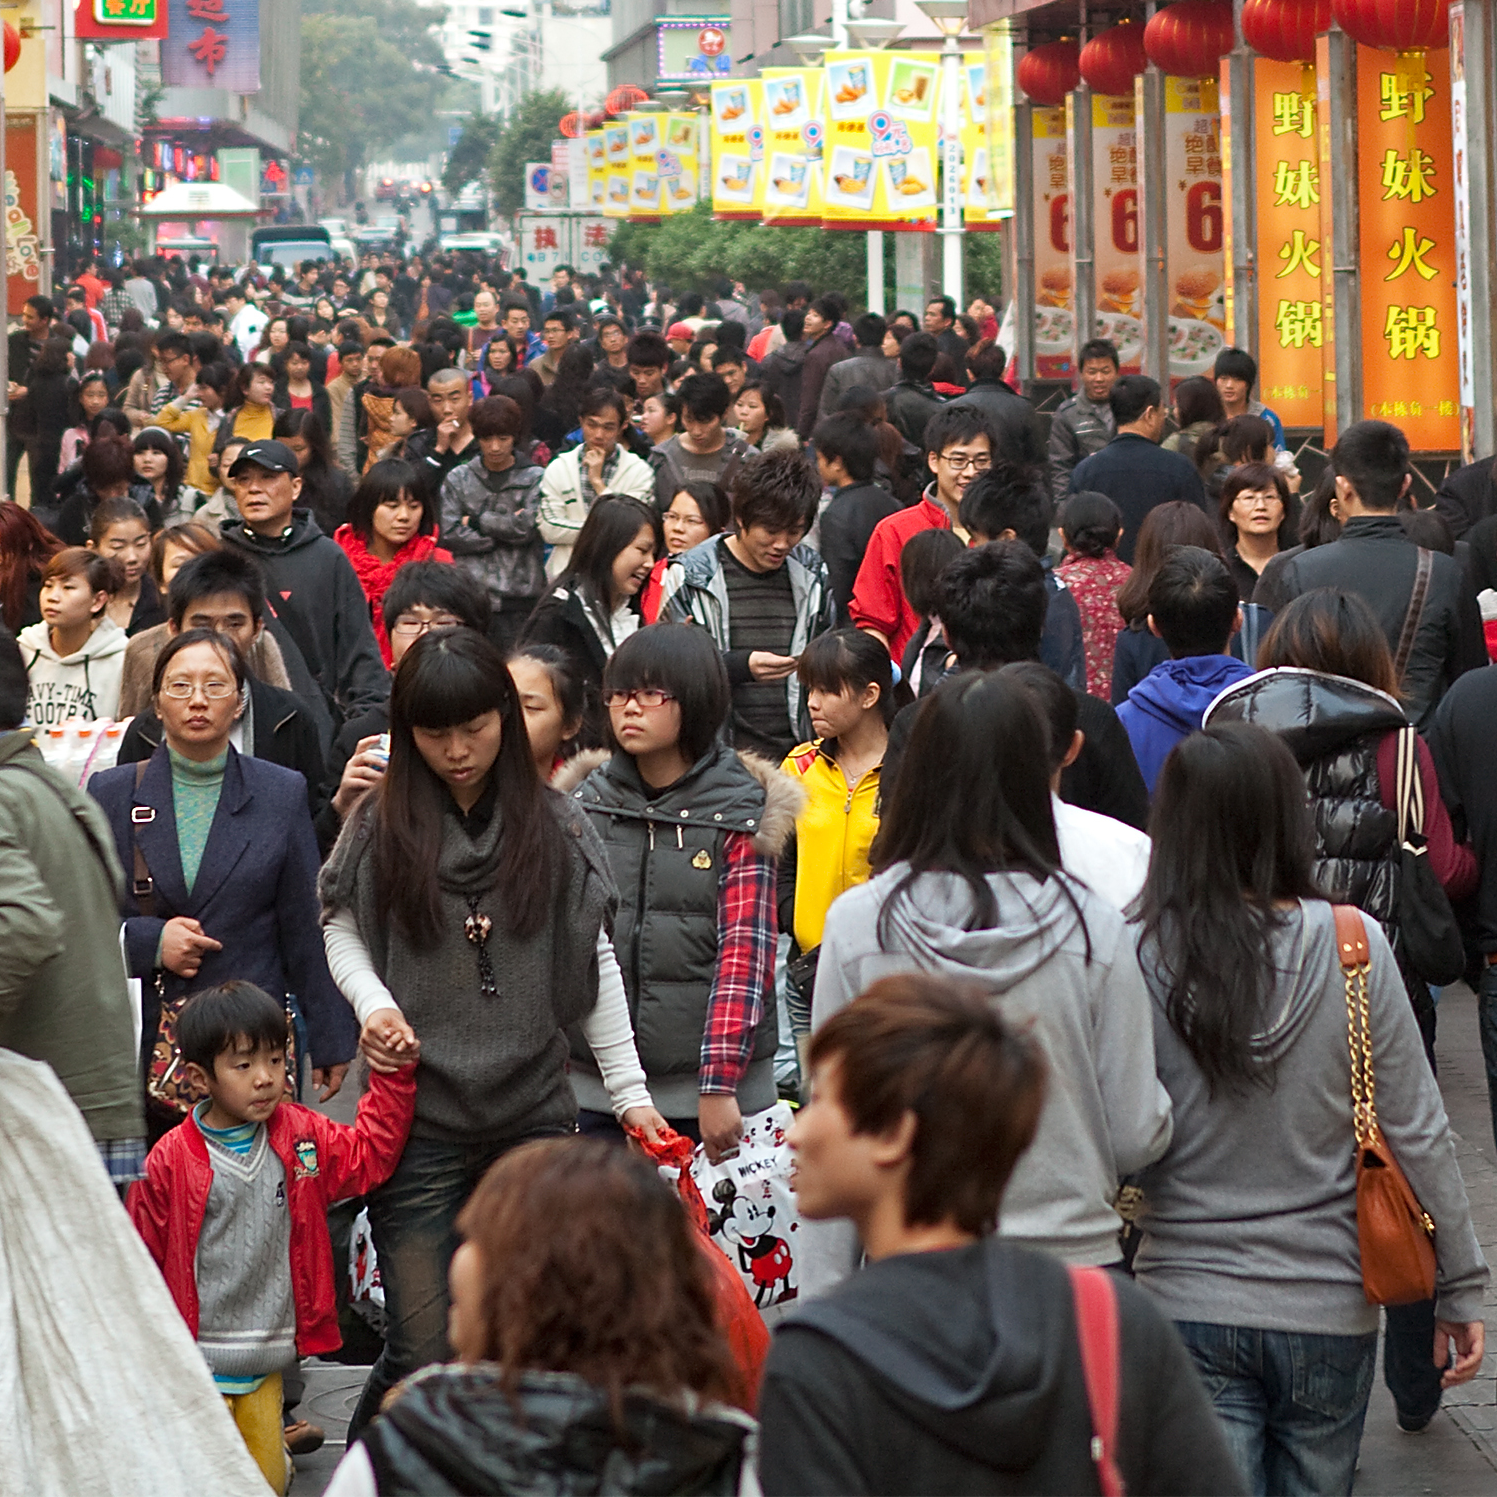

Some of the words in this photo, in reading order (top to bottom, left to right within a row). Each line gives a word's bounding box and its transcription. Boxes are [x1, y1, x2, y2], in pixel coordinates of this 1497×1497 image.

[1272, 90, 1324, 350] 野妹火锅
[1378, 70, 1442, 361] 野妹火锅
[738, 1155, 778, 1178] MICKEY
